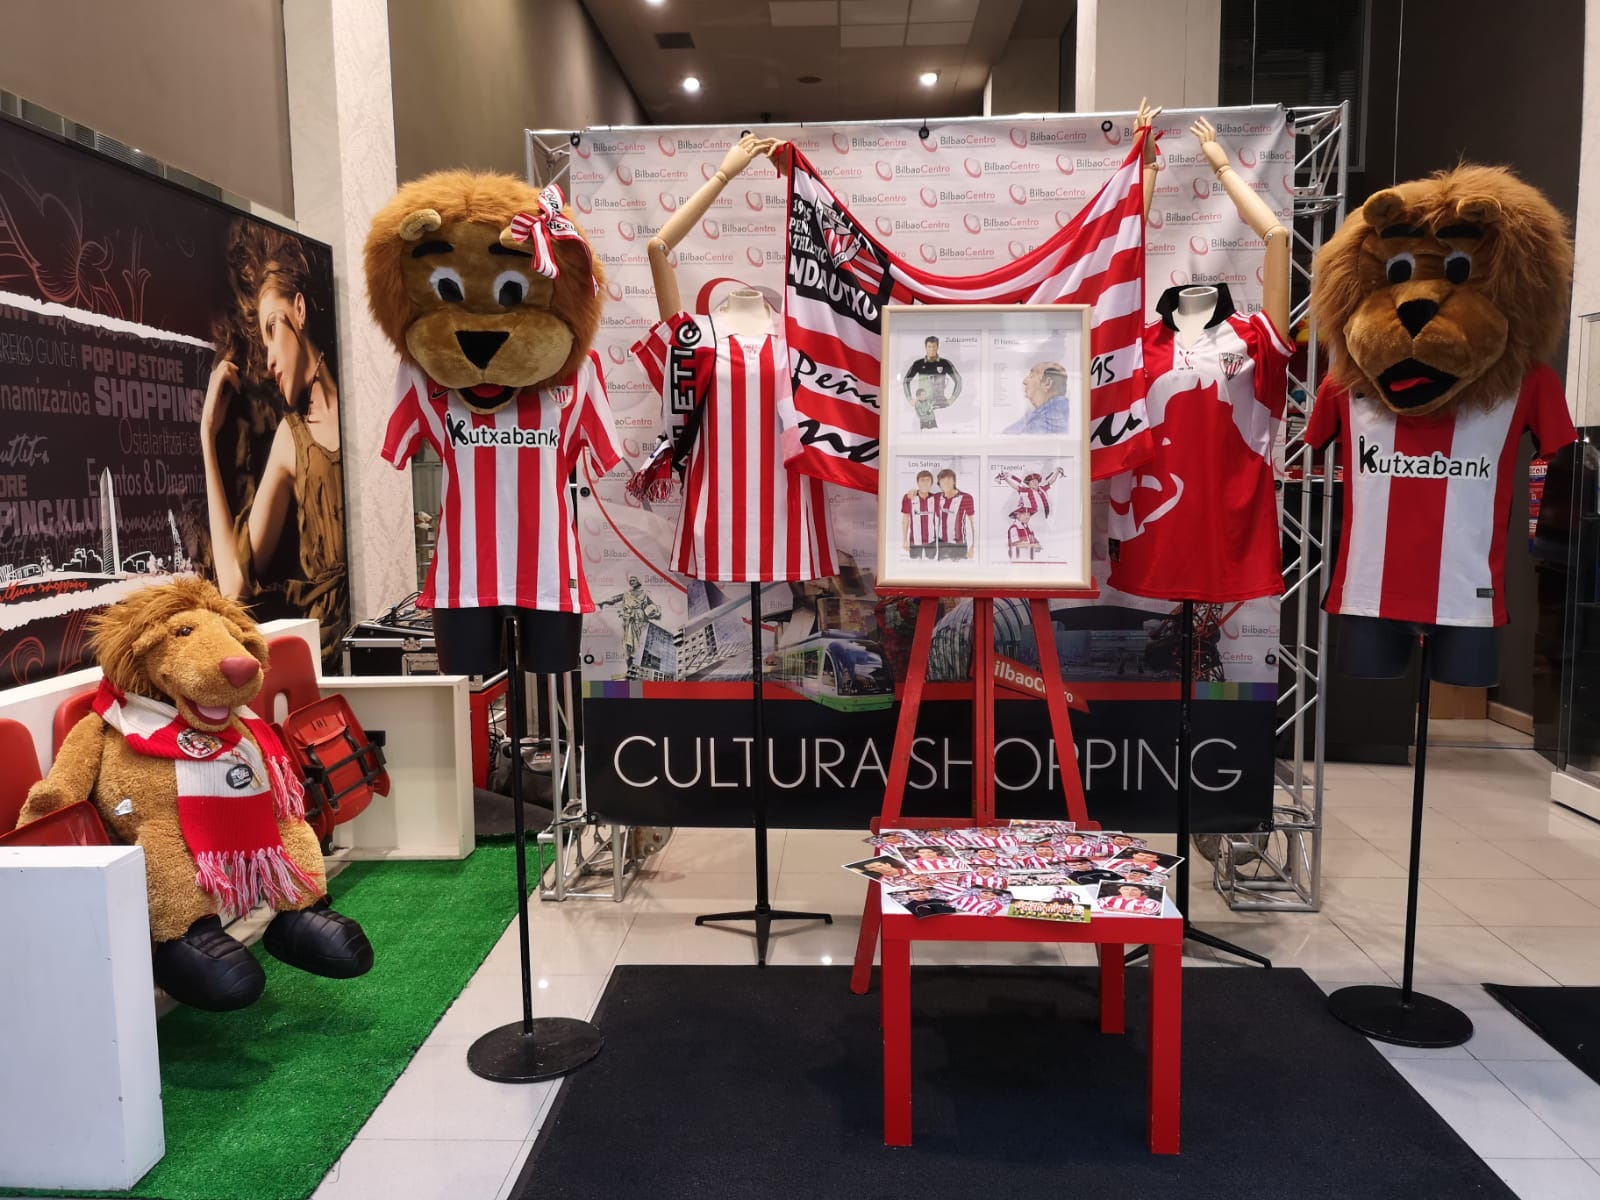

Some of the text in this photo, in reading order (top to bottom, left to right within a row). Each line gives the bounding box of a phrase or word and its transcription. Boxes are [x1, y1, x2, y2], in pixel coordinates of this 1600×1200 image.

[1217, 124, 1272, 133] BilbaoCentro
[940, 135, 996, 145] BilbaoCentro
[1030, 131, 1087, 141] BilbaoCentro
[593, 142, 646, 152] BilbaoCentro
[678, 139, 732, 149] BilbaoCentro
[852, 137, 907, 147] BilbaoCentro
[896, 165, 950, 174] BilbaoCentro
[984, 161, 1040, 171] BilbaoCentro
[635, 169, 688, 178] BilbaoCentro
[940, 190, 996, 200] BilbaoCentro
[1029, 187, 1086, 198] BilbaoCentro
[594, 199, 647, 208] BilbaoCentro
[852, 194, 906, 203] BilbaoCentro
[984, 218, 1040, 227] BilbaoCentro
[1166, 213, 1222, 222] BilbaoCentro
[722, 224, 776, 233] BilbaoCentro
[896, 220, 950, 230] BilbaoCentro
[680, 253, 734, 261] BilbaoCentro
[939, 247, 995, 257] BilbaoCentro
[1192, 274, 1247, 282] BilbaoCentro
[788, 254, 878, 321] NDAUTXU
[81, 344, 114, 373] POP
[117, 348, 137, 376] UP
[139, 353, 184, 384] STORE
[673, 322, 700, 411] ETIC
[1091, 355, 1115, 386] 95
[447, 413, 558, 447] Kutxabank
[1359, 435, 1491, 478] Kutxabank
[613, 735, 1243, 791] CULTURA SHOPPING
